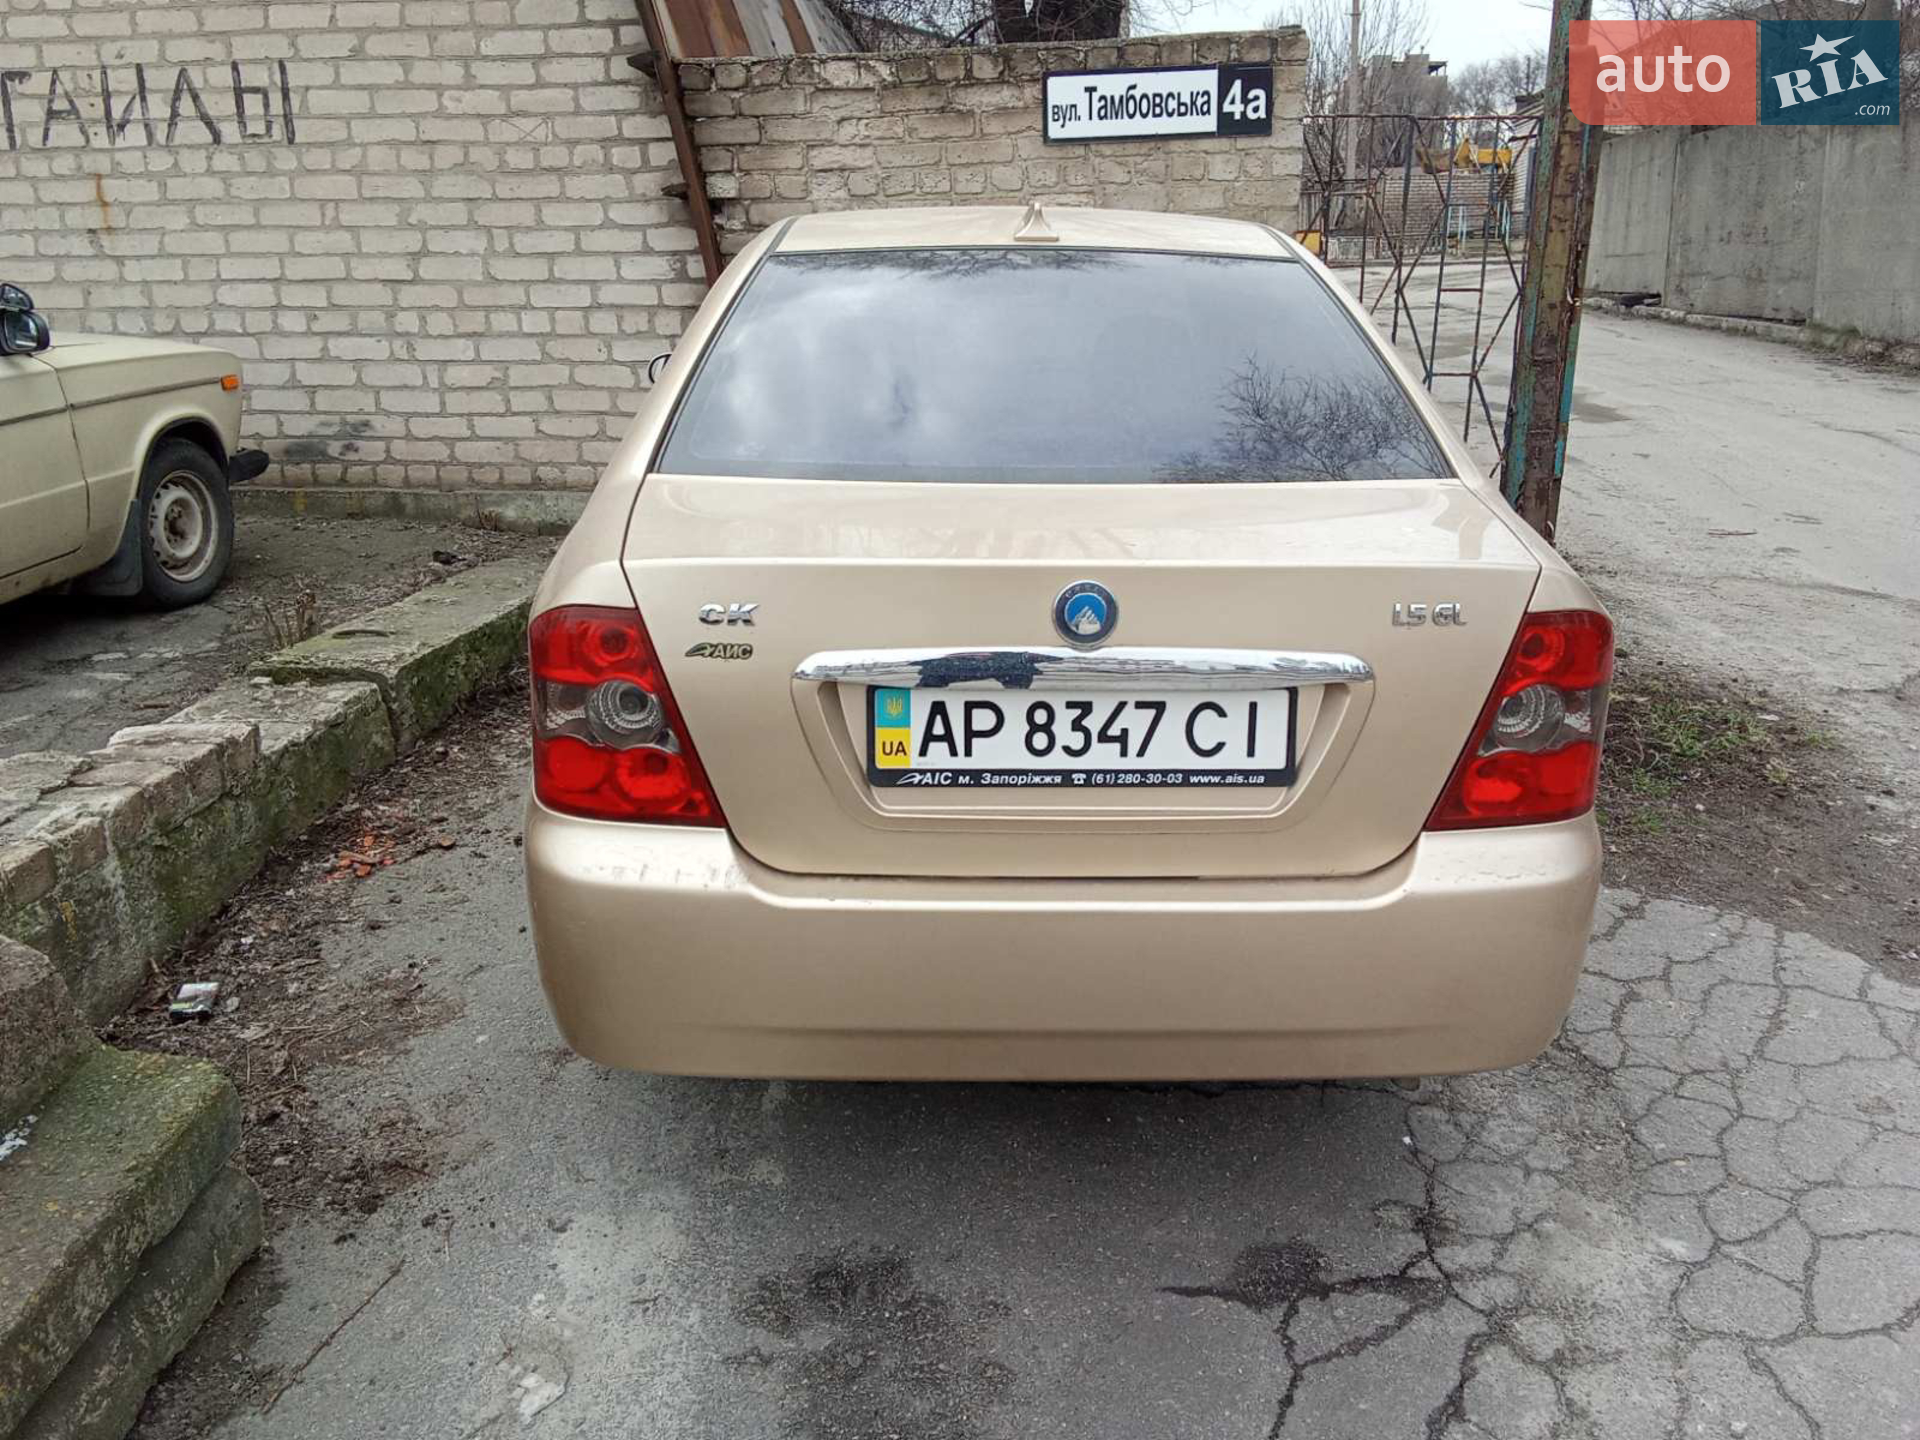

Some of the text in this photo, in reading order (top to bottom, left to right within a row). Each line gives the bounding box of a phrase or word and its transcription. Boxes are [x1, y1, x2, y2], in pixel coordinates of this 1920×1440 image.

[1052, 104, 1081, 128] вул.
[1084, 84, 1212, 121] Тамбовська
[699, 603, 760, 626] CK
[918, 700, 1005, 758] AP
[1025, 700, 1166, 758] 8347
[882, 741, 907, 756] UA
[981, 773, 1062, 787] Запоріжжя
[1189, 773, 1265, 785] www.ais.ua
